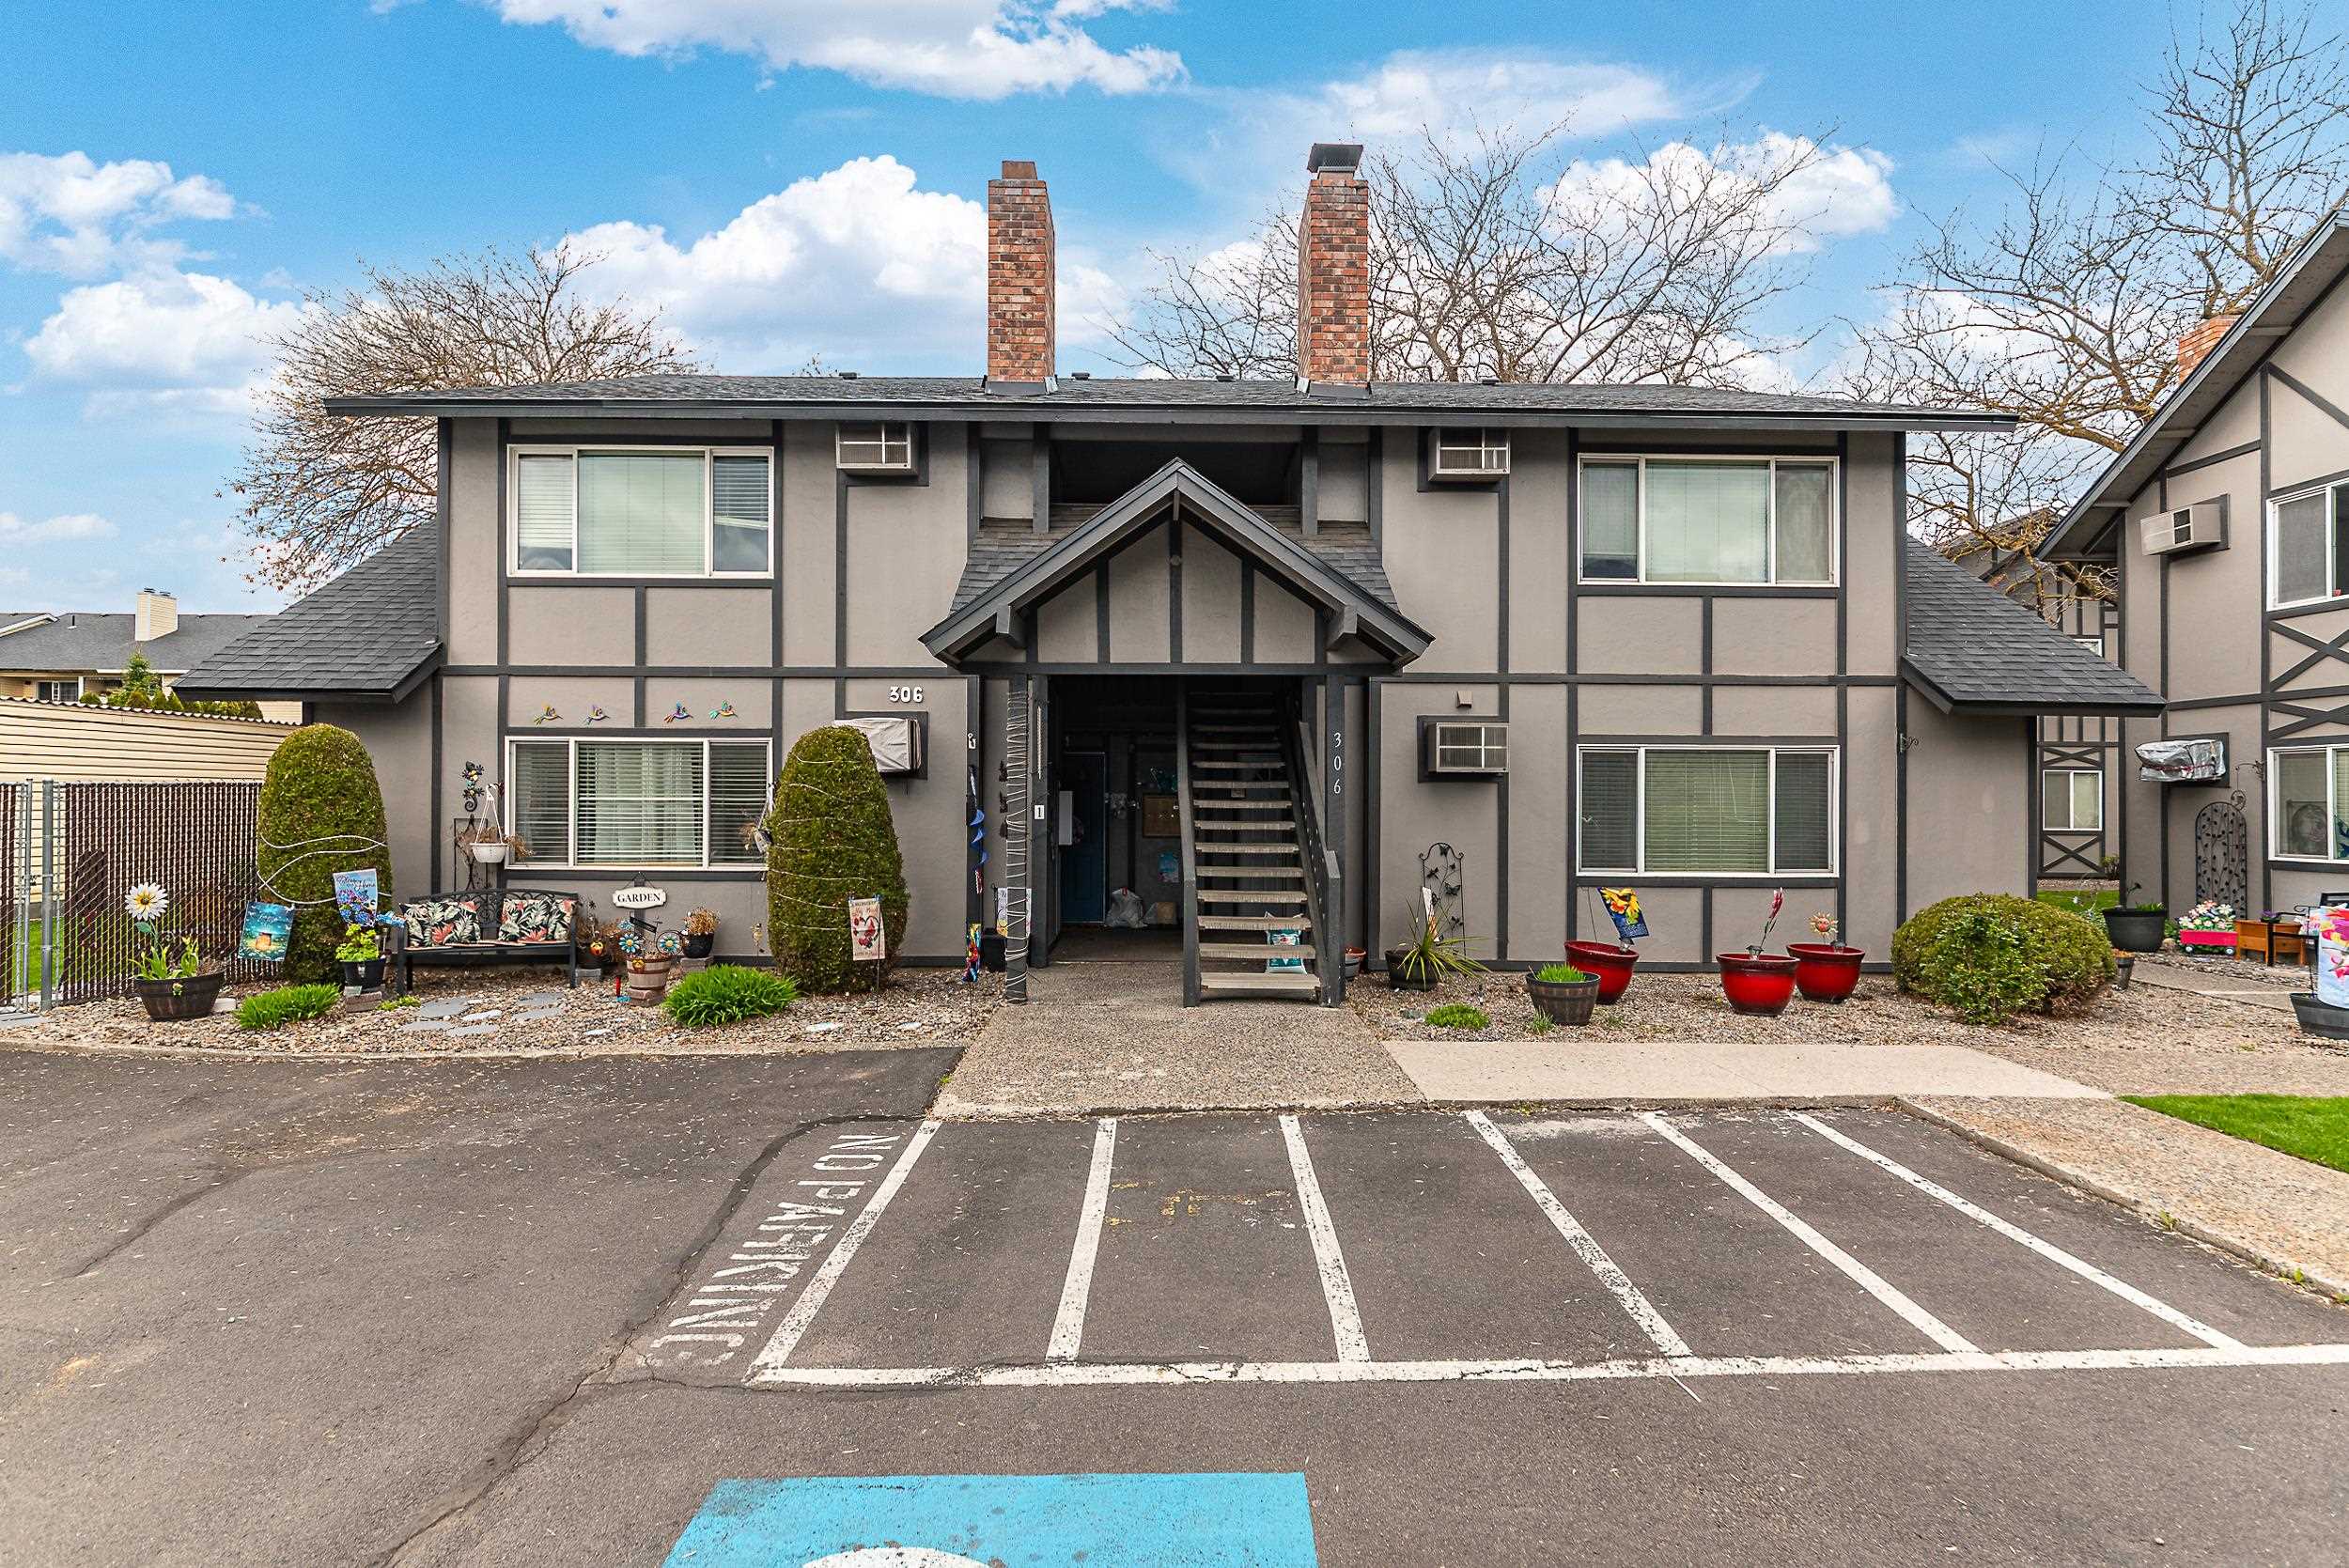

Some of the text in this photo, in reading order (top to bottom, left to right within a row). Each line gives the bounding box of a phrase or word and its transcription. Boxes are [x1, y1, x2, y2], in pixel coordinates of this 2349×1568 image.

[889, 686, 923, 703] 306
[1333, 732, 1342, 794] 306
[616, 893, 661, 903] GARDEN
[637, 1134, 900, 1367] NO PARKING
